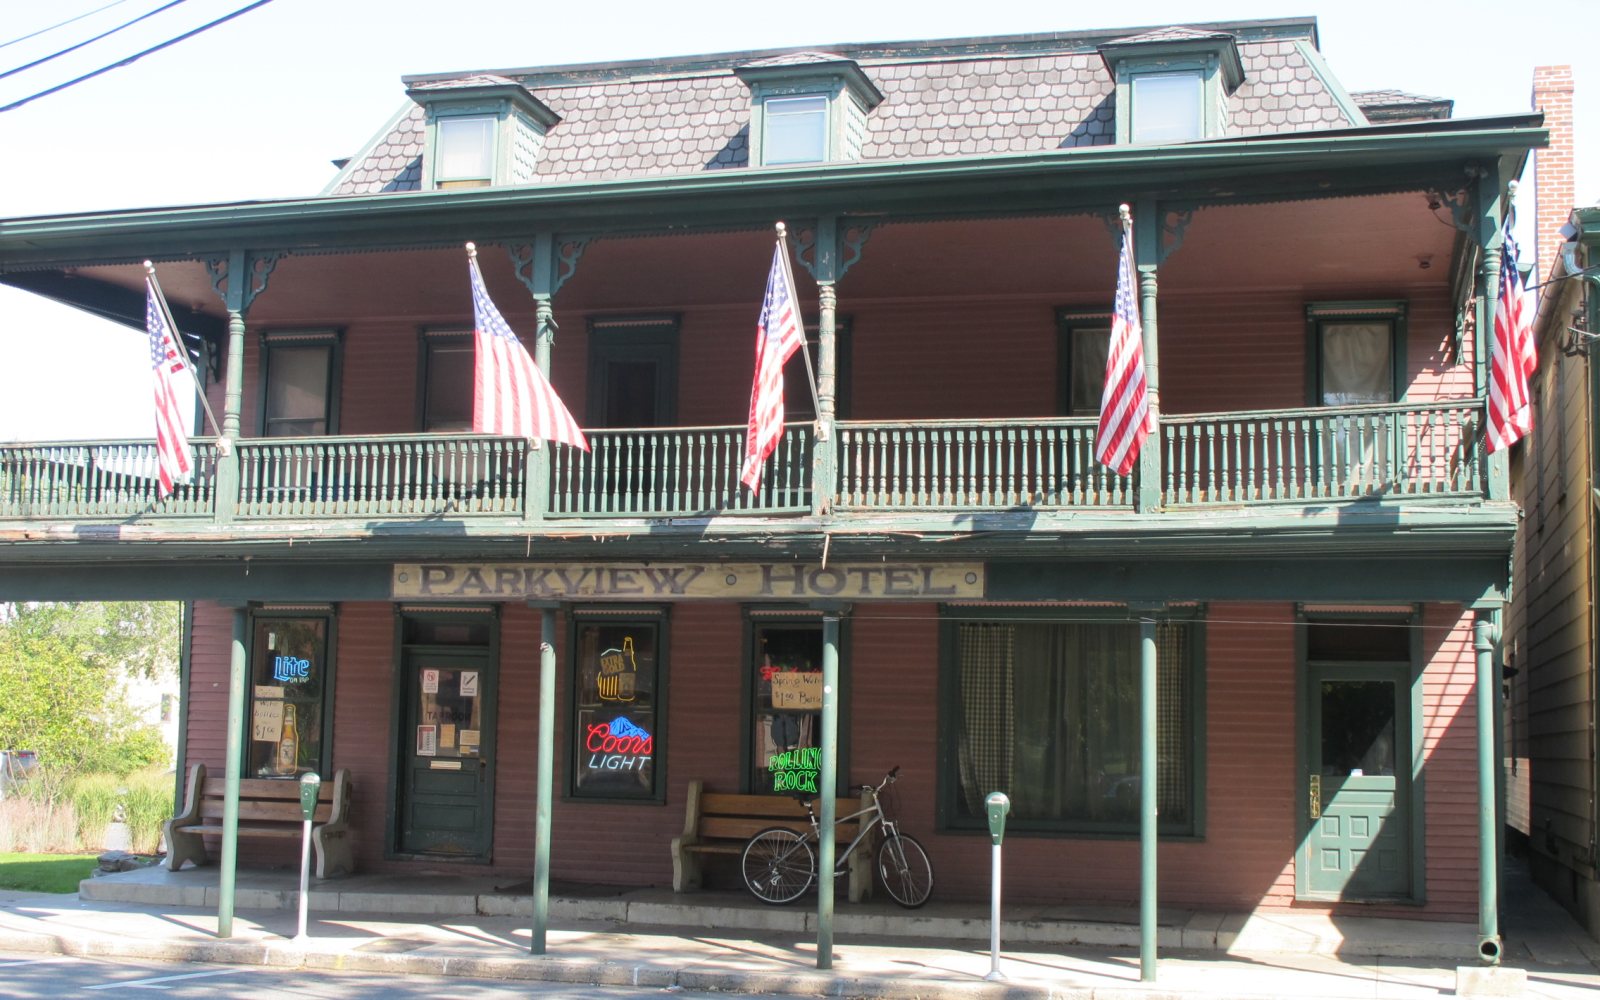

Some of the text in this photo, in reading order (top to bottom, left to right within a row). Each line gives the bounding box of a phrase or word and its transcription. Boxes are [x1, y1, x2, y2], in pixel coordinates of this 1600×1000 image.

[420, 564, 957, 596] PARKVIEW HOTEL
[273, 656, 310, 682] Lite
[803, 674, 822, 684] Wate
[587, 723, 653, 754] Coors
[589, 754, 652, 770] LIGHT
[774, 771, 818, 793] ROCK
